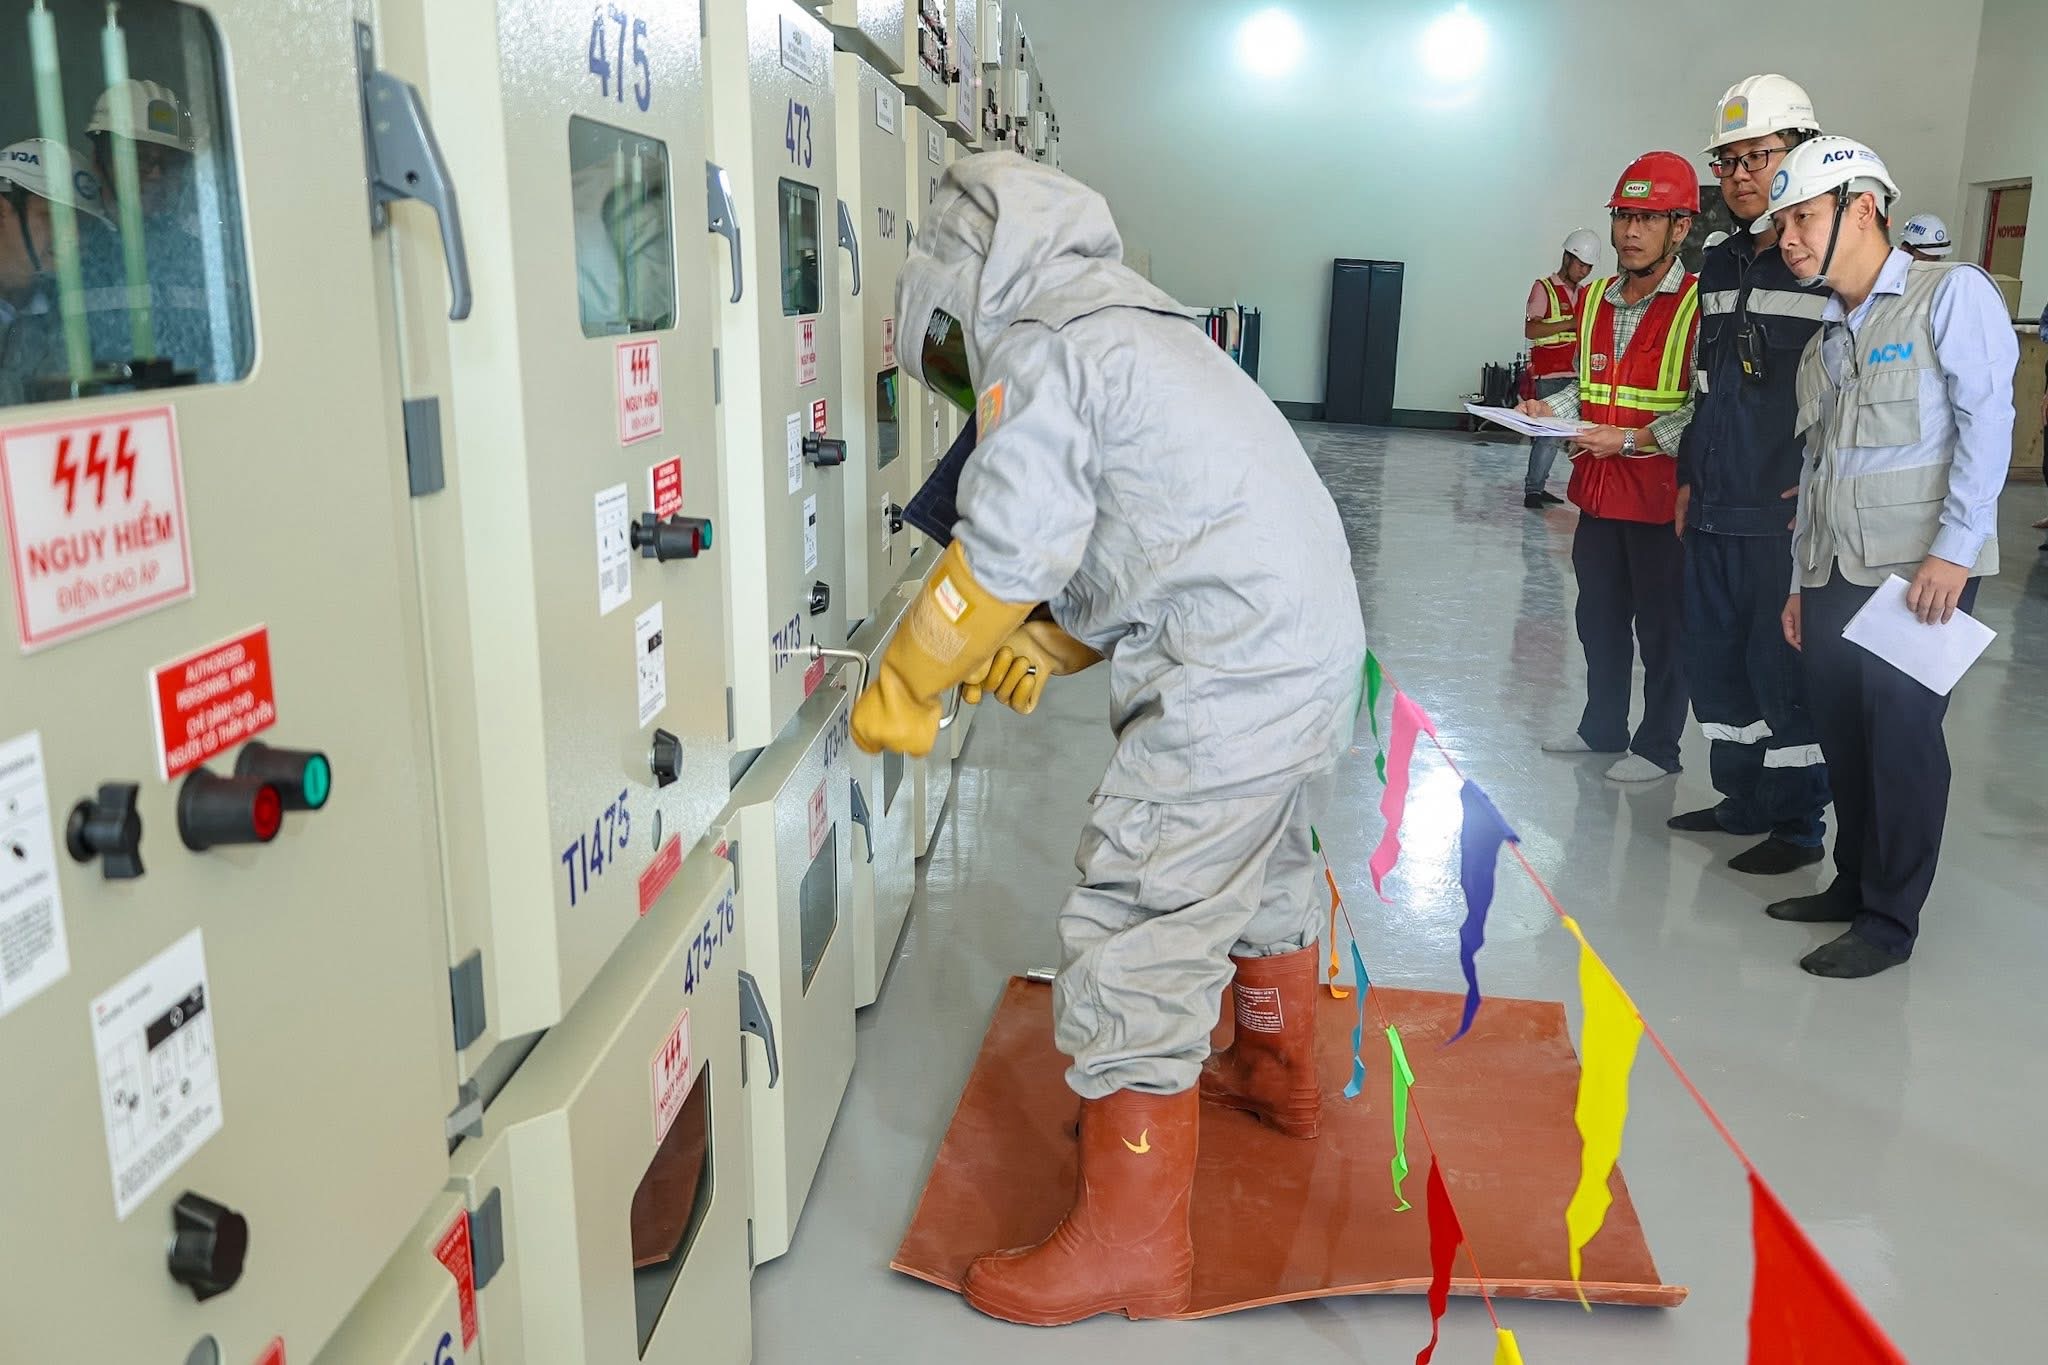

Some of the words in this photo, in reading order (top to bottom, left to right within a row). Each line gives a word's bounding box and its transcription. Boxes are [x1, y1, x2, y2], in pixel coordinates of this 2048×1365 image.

[588, 2, 651, 112] 475
[785, 98, 812, 168] 473
[1822, 150, 1854, 164] ACV
[1868, 342, 1914, 366] ACV
[26, 528, 107, 580] NGUY
[113, 501, 174, 555] HIỂM
[56, 576, 99, 614] ĐIỆN
[103, 567, 138, 597] CAO
[823, 708, 849, 769] 473-76
[684, 888, 734, 995] 475-76
